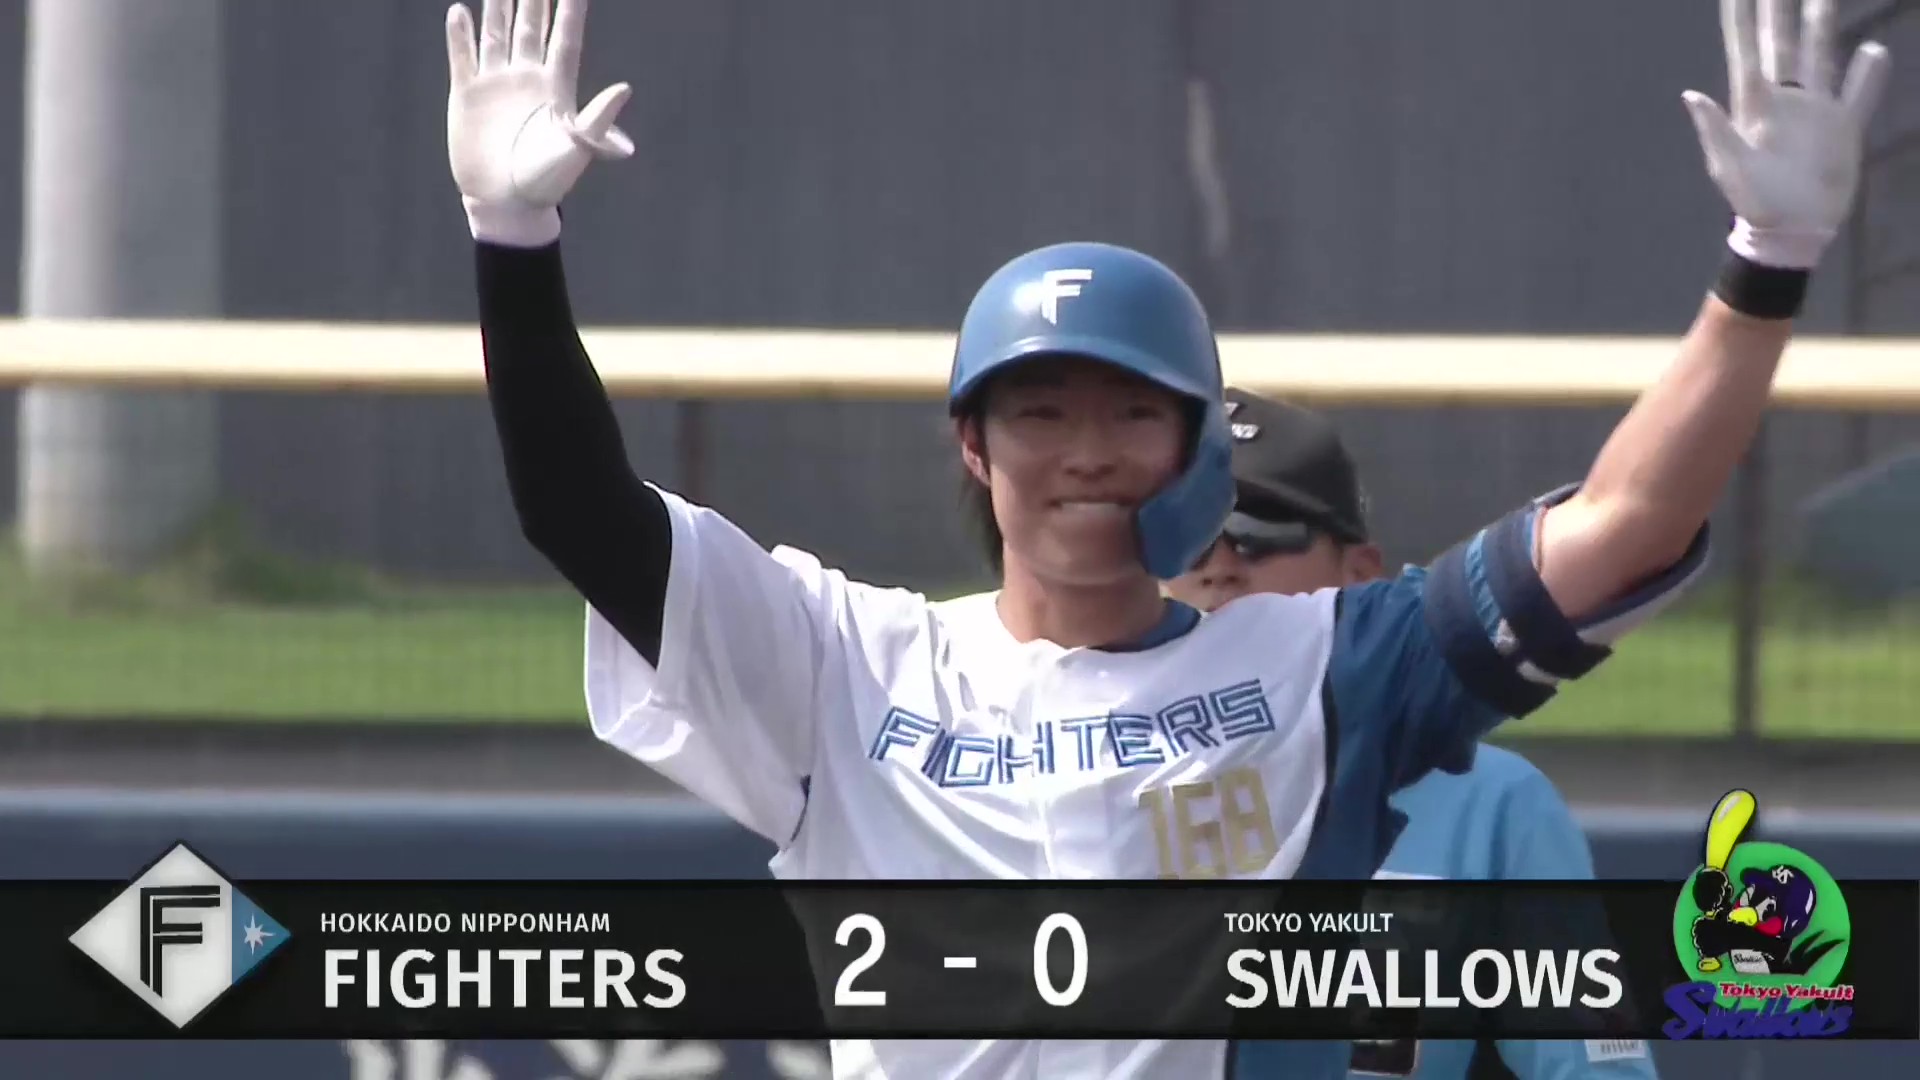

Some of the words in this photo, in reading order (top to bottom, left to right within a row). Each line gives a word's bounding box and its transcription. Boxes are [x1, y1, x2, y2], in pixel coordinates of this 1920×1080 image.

[1041, 268, 1092, 325] F
[868, 678, 1276, 788] FIGHTERS
[1137, 766, 1279, 880] 168
